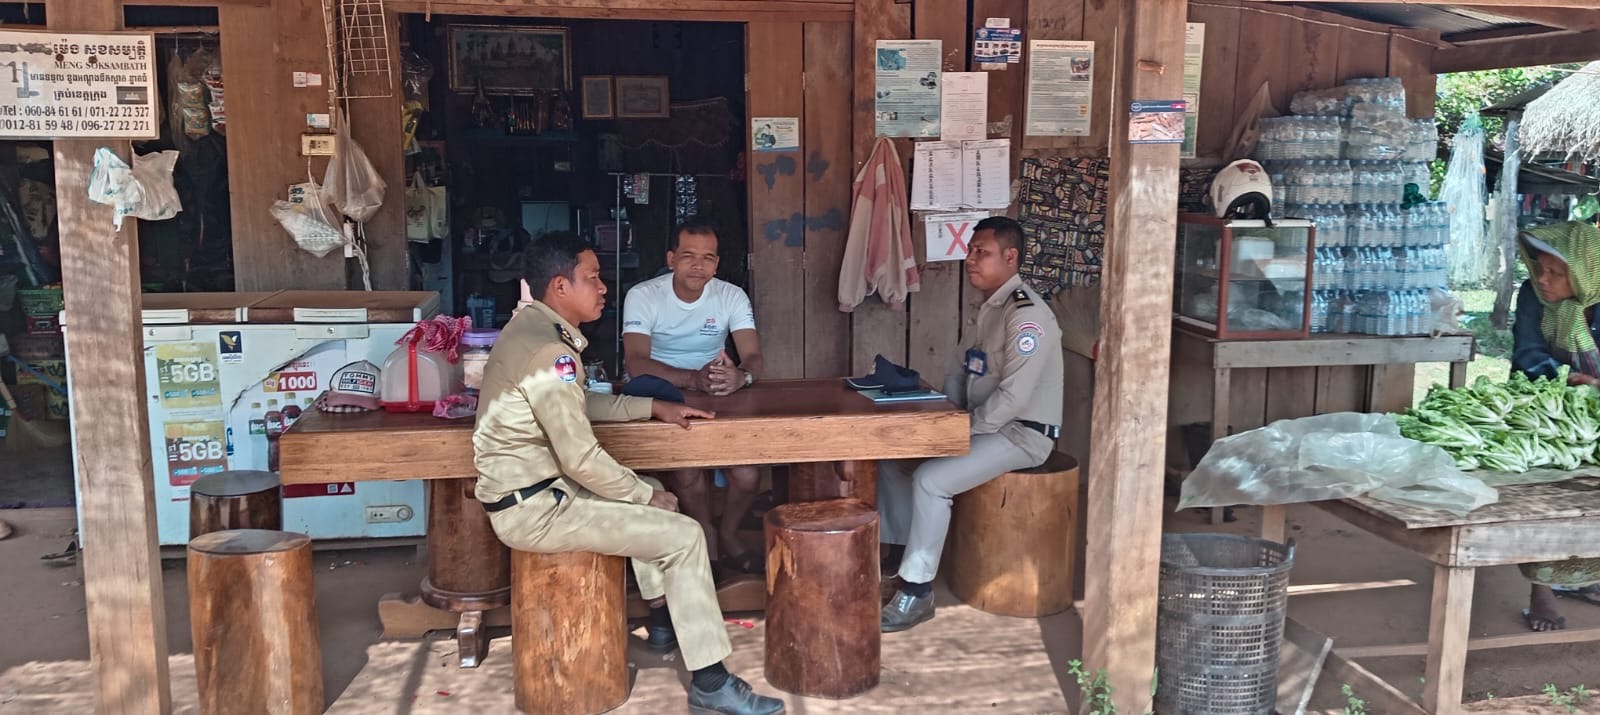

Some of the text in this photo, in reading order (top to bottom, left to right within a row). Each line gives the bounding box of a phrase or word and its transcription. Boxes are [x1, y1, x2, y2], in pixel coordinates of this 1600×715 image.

[84, 40, 146, 60] សខសម្បត្តិ
[54, 61, 147, 70] MENG SOKSAMBATH
[3, 105, 17, 117] Tel
[25, 106, 56, 117] 060-84
[58, 106, 69, 117] 61
[72, 106, 82, 117] 61
[90, 106, 119, 117] 071-22
[122, 106, 132, 117] 22
[134, 106, 149, 117] 327
[45, 119, 57, 131] 59
[60, 120, 73, 131] 48
[81, 120, 115, 131] 096-27
[118, 120, 130, 131] 22
[133, 120, 149, 131] 271
[170, 363, 214, 384] 5GB
[179, 441, 223, 462] 5GB
